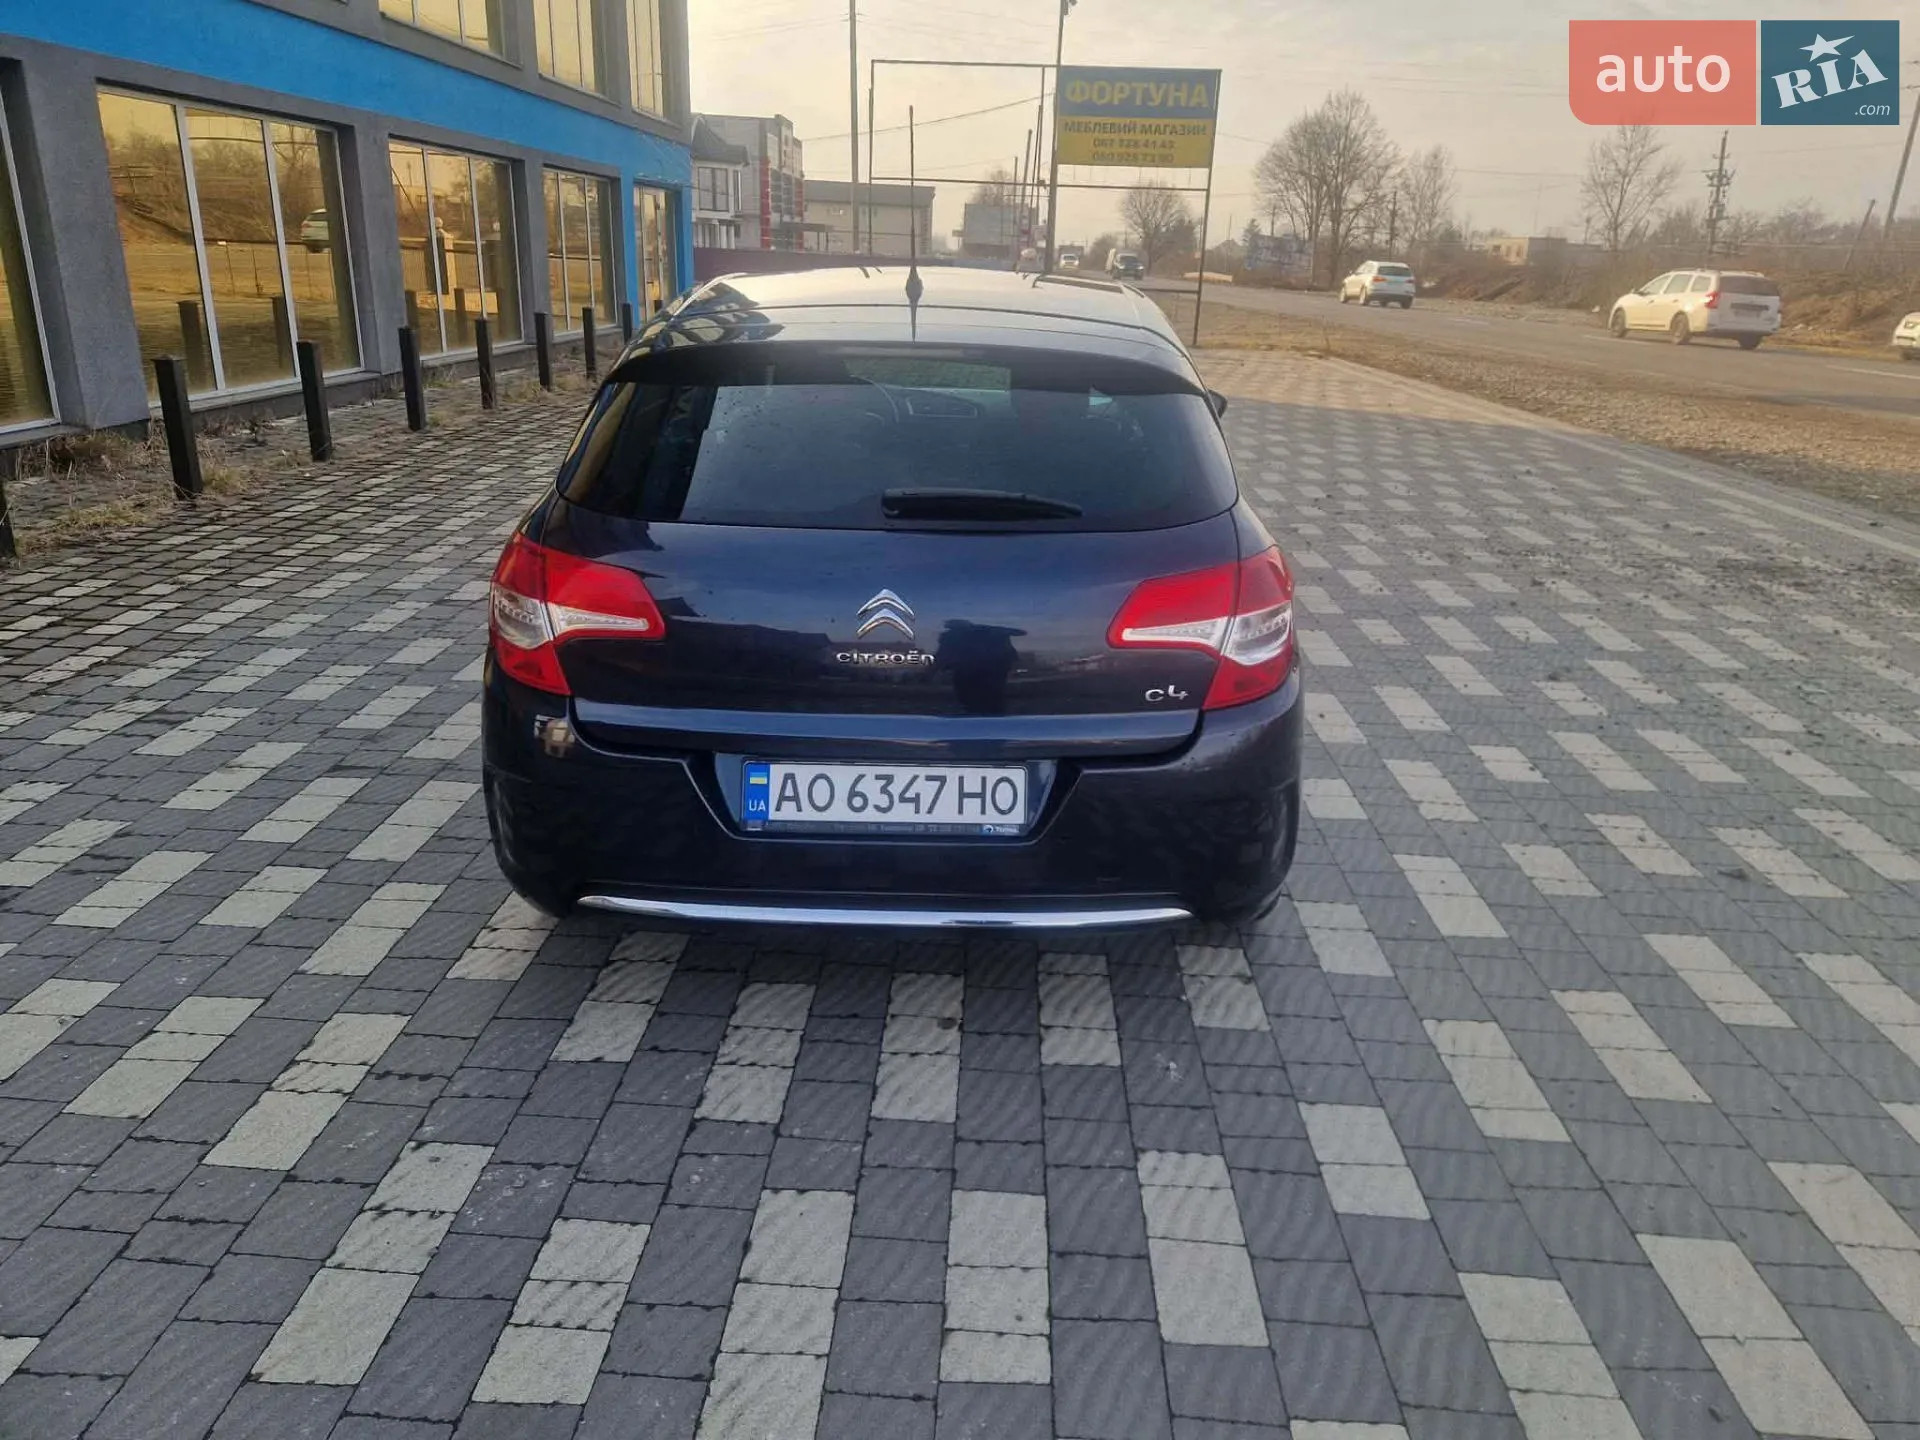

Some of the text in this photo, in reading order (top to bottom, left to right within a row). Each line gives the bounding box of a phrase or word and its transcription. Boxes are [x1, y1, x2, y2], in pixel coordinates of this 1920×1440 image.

[1065, 78, 1209, 108] ФОРТУНА
[1064, 119, 1206, 136] МЕБЛЕВИЙ МАГАЗИН
[1144, 684, 1188, 703] C4
[774, 772, 1018, 815] AO 6347 HO
[749, 800, 766, 811] UA
